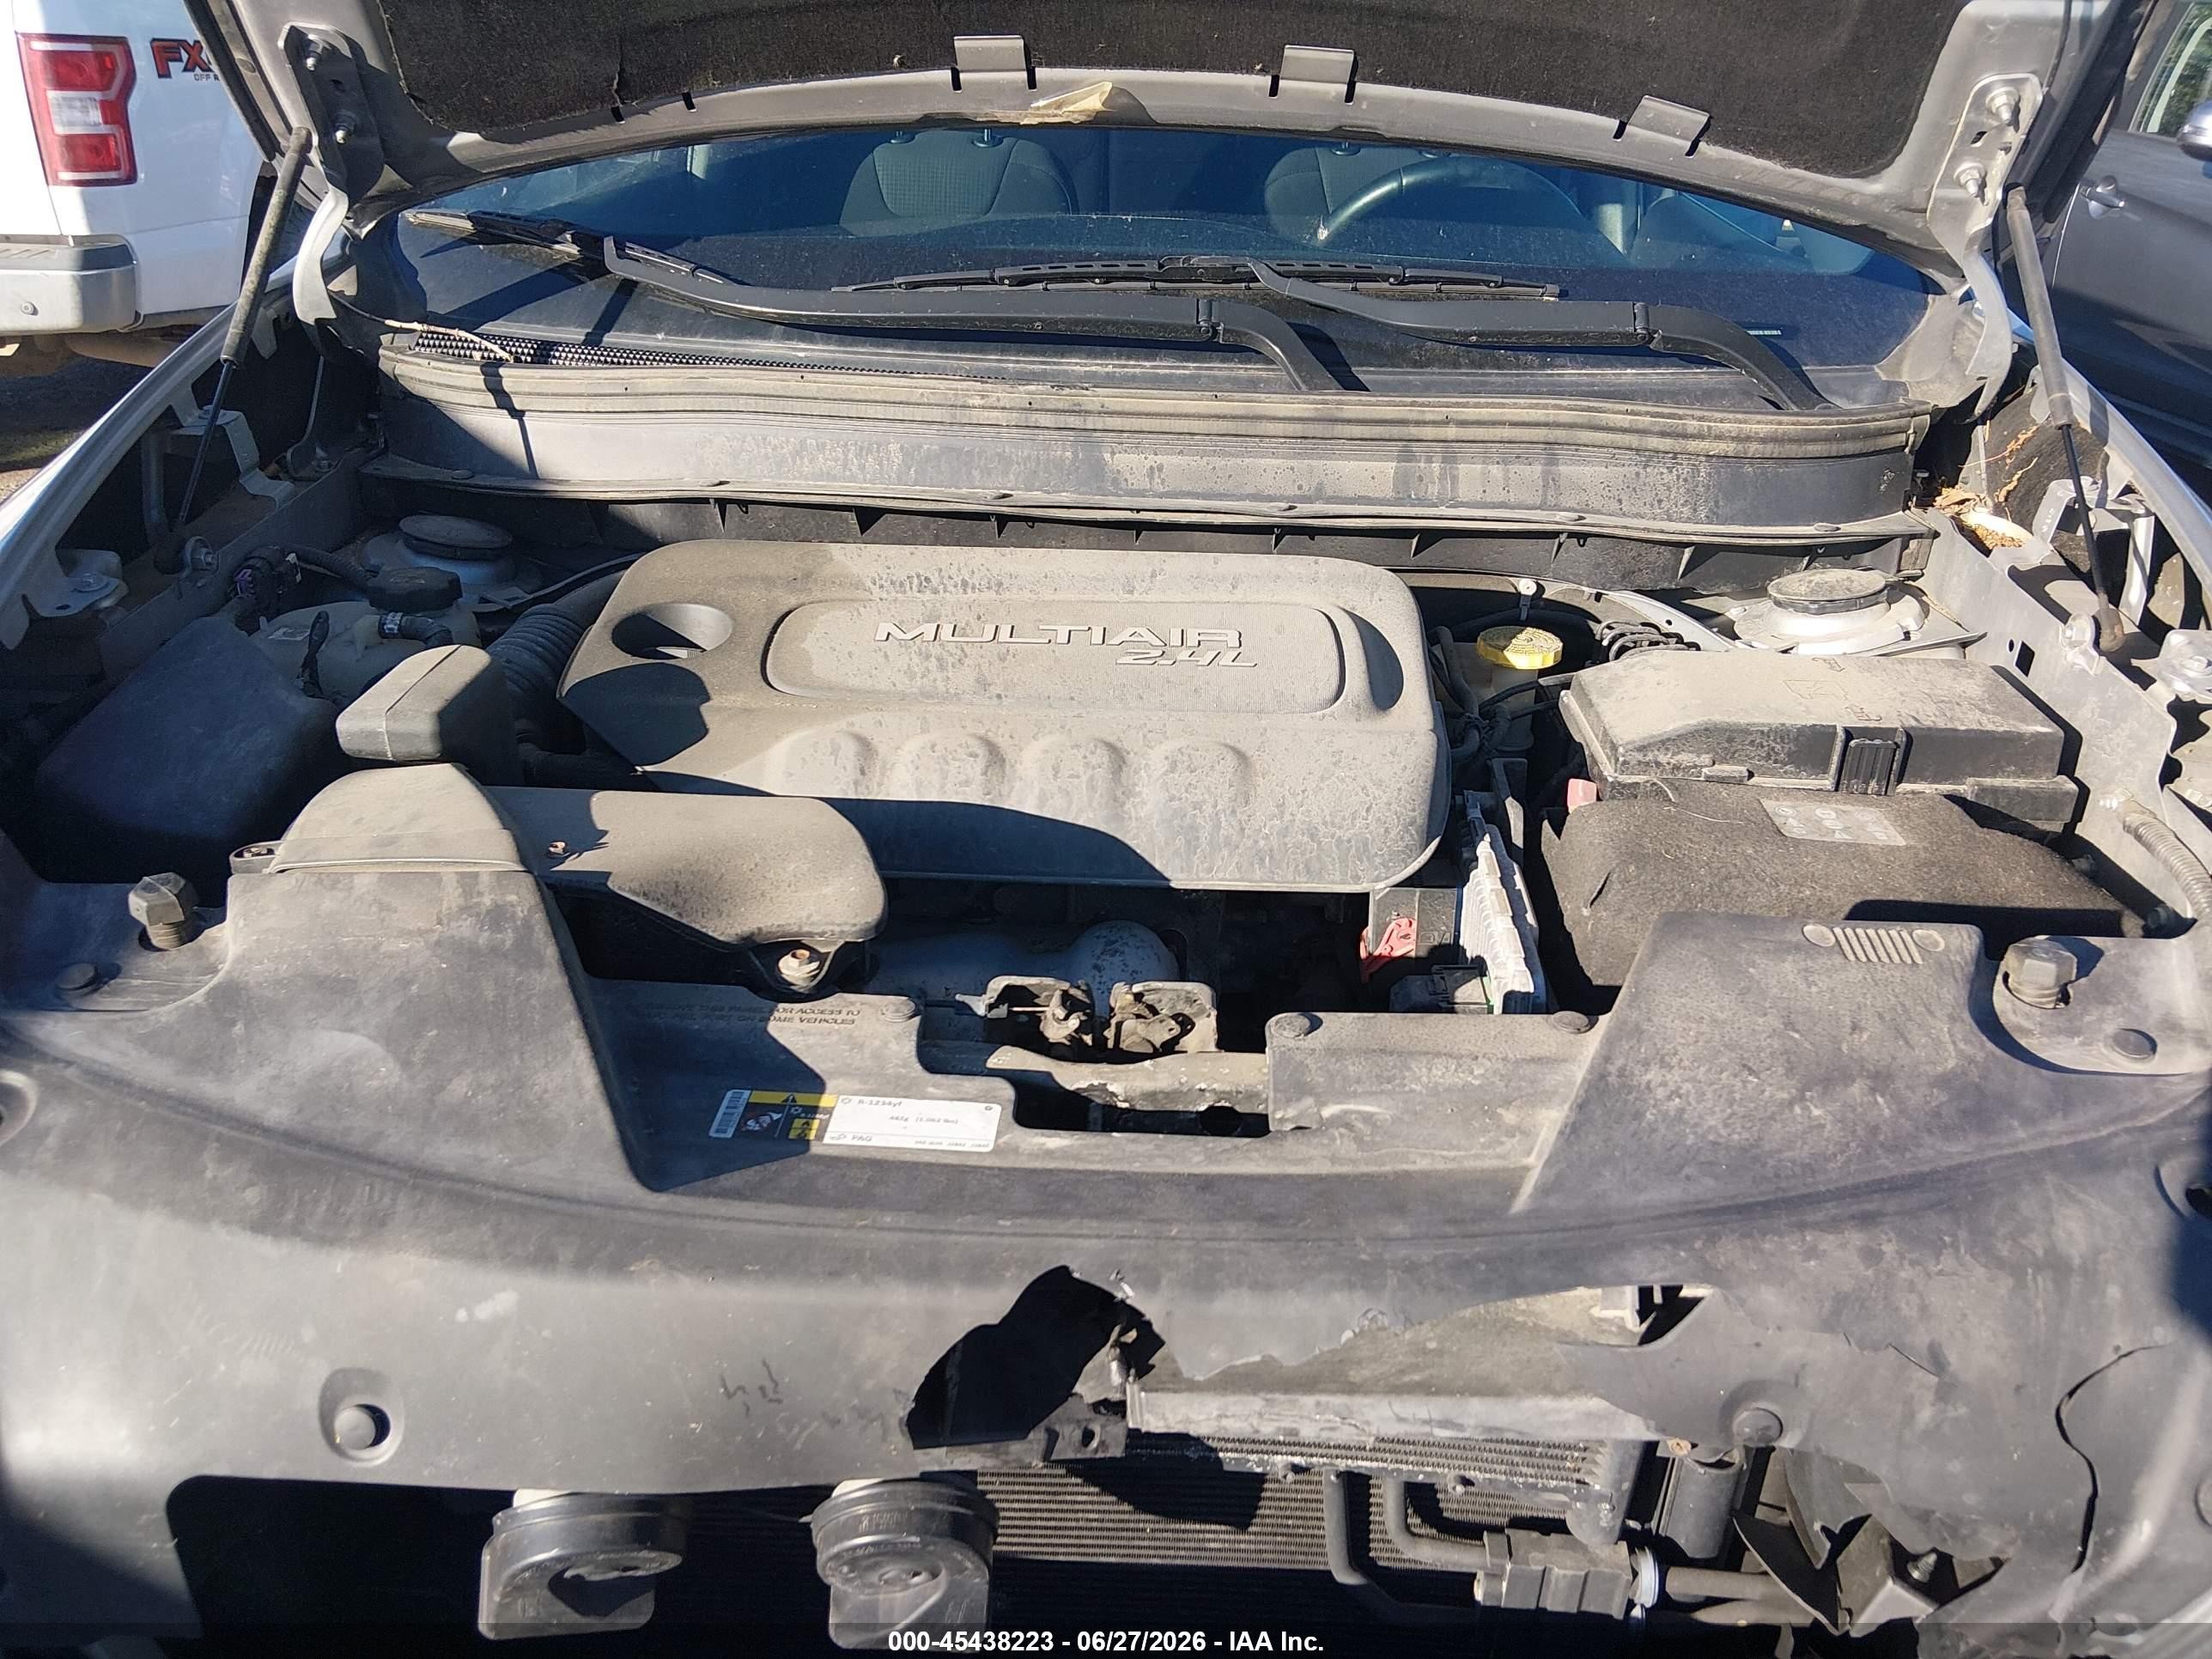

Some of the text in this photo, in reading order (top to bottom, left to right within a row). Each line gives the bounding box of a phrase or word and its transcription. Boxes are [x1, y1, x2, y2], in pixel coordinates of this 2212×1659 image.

[149, 38, 212, 79] FX
[874, 621, 1243, 649] MULTIAIR
[1115, 648, 1258, 668] 2.4L
[795, 1007, 843, 1016] ACCESS
[846, 1008, 861, 1017] TO
[799, 1017, 856, 1025] VEHICLES
